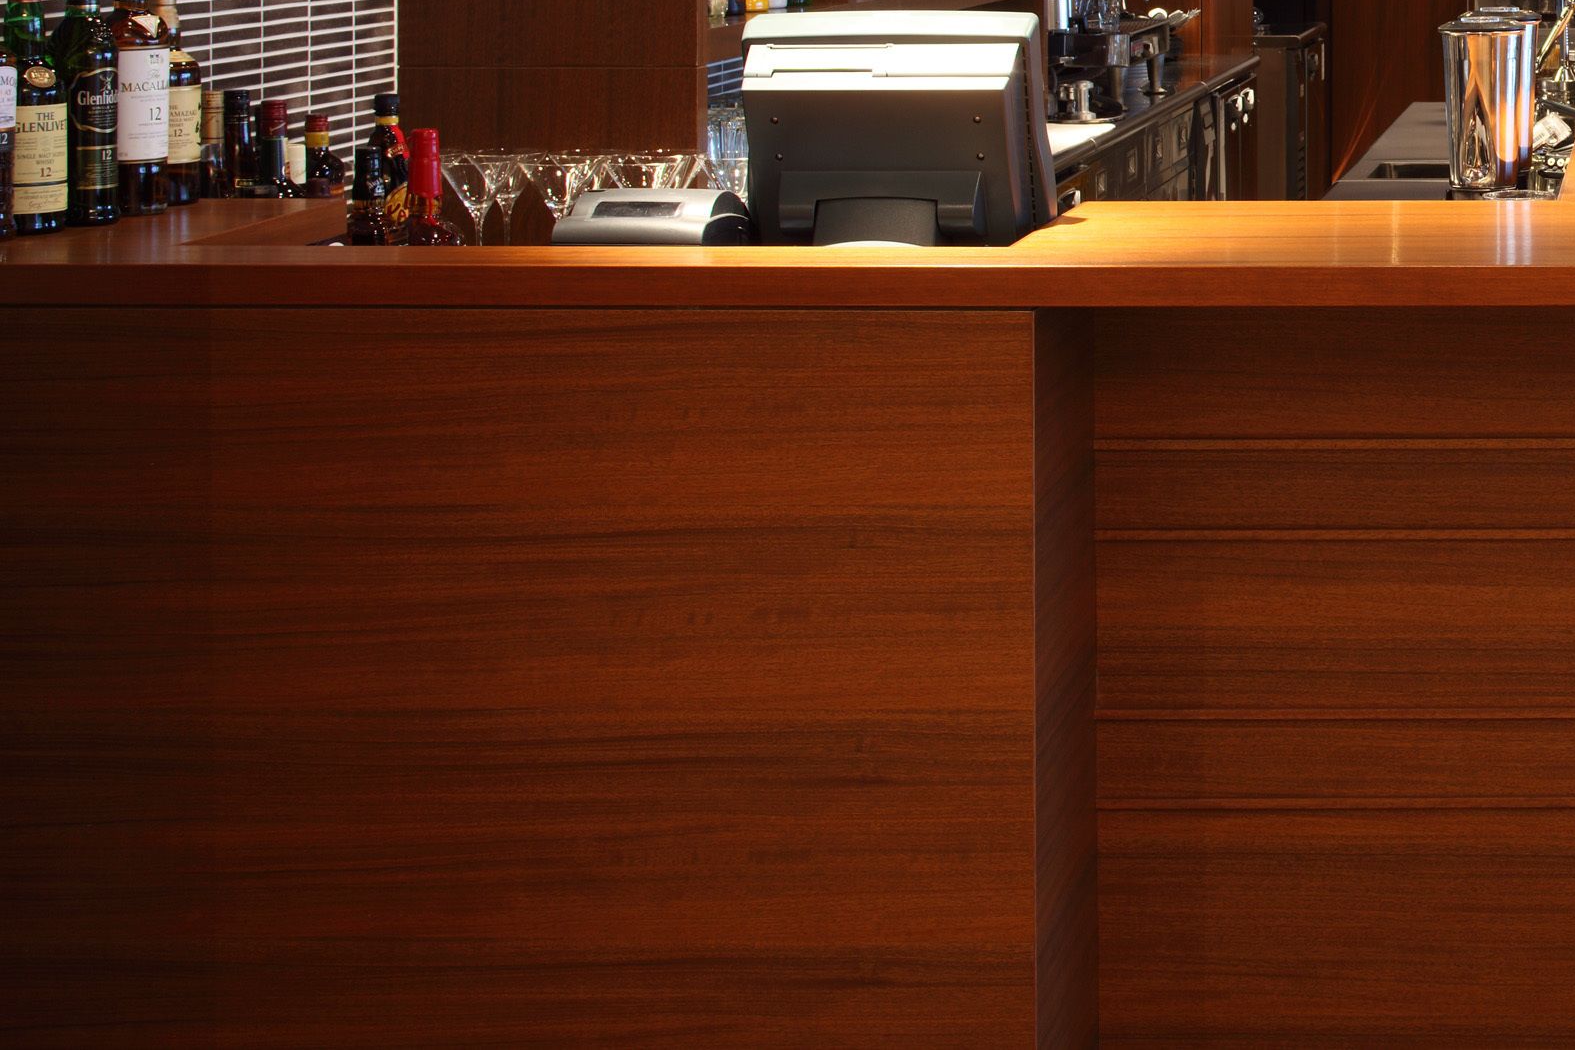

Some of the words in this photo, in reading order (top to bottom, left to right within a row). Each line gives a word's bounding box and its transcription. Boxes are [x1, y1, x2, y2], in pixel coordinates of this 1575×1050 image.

[35, 111, 56, 121] THE
[149, 106, 162, 121] 12
[172, 128, 183, 138] 12
[102, 149, 113, 161] 12
[40, 167, 52, 178] 12
